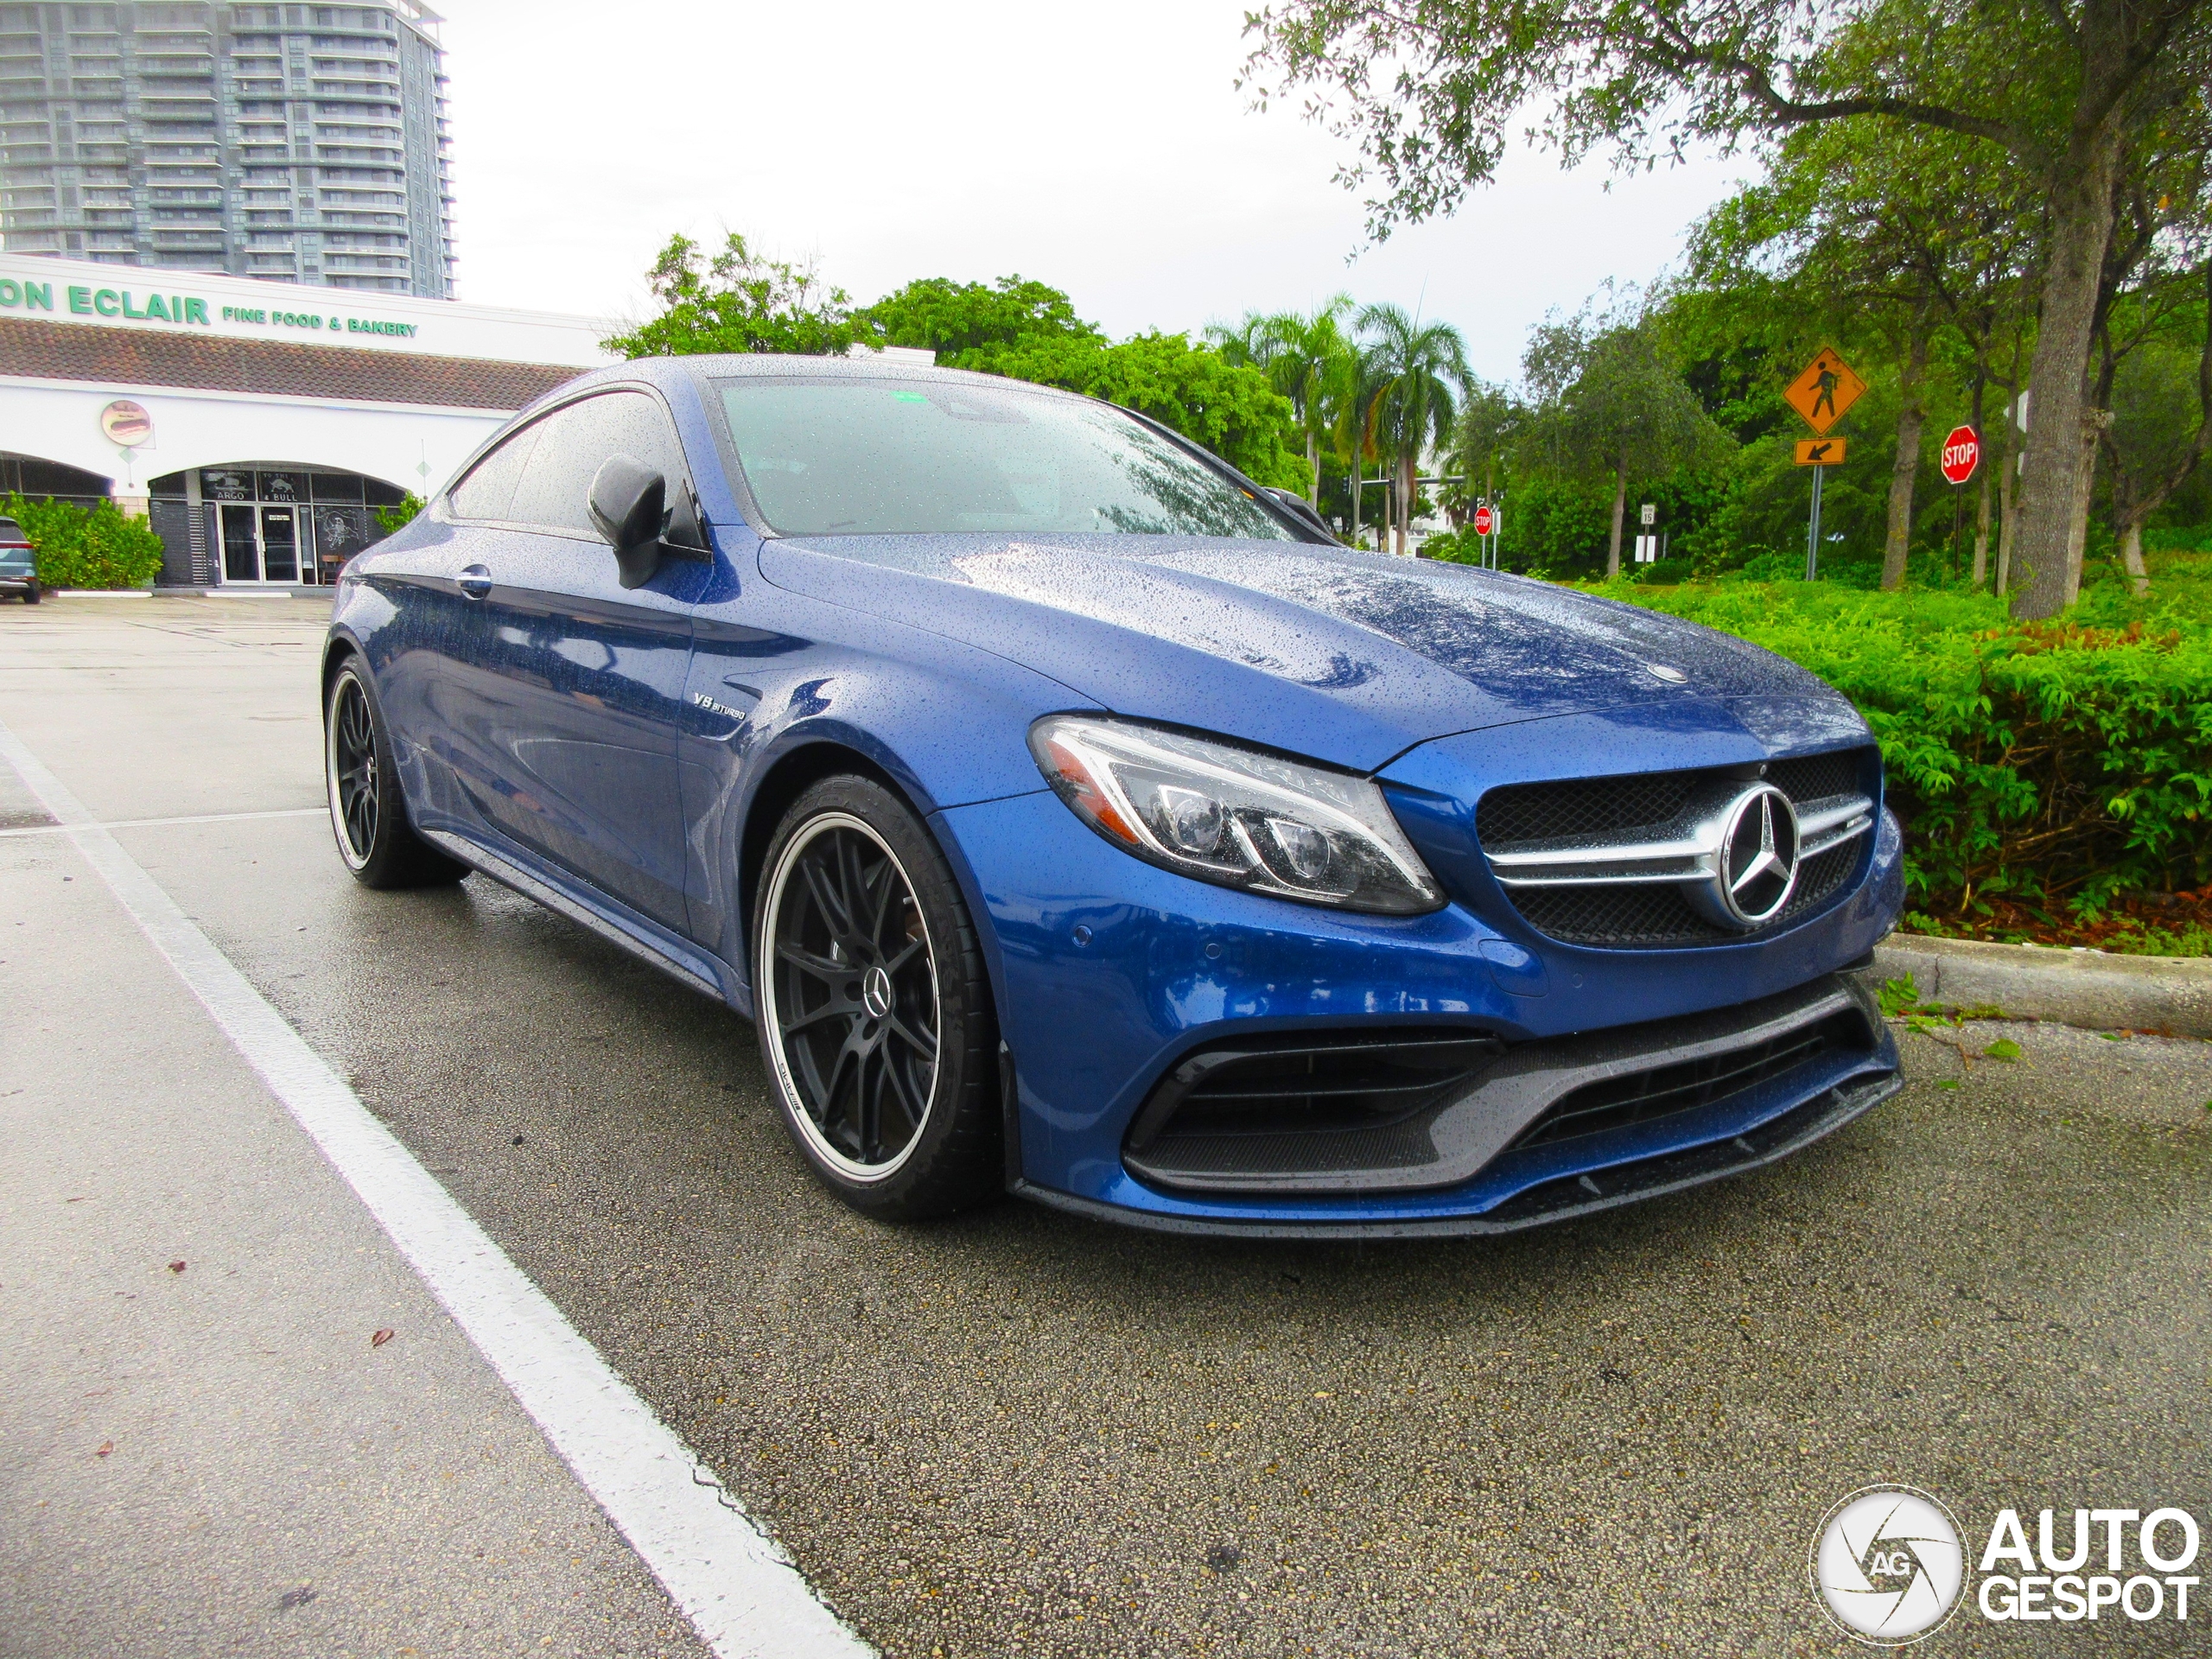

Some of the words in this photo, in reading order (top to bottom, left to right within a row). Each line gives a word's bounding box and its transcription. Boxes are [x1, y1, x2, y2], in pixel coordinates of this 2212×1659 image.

[69, 285, 211, 325] ECLAIR
[223, 306, 267, 323] FINE
[272, 311, 323, 328] FOOD
[329, 317, 342, 330] &
[348, 318, 418, 338] BAKERY
[1944, 442, 1975, 467] STOP
[217, 492, 245, 500] ARGO
[273, 493, 298, 502] BULL
[1476, 516, 1491, 526] STOP
[1644, 513, 1652, 522] 15
[694, 692, 714, 709] V8
[712, 702, 746, 720] BITURBO
